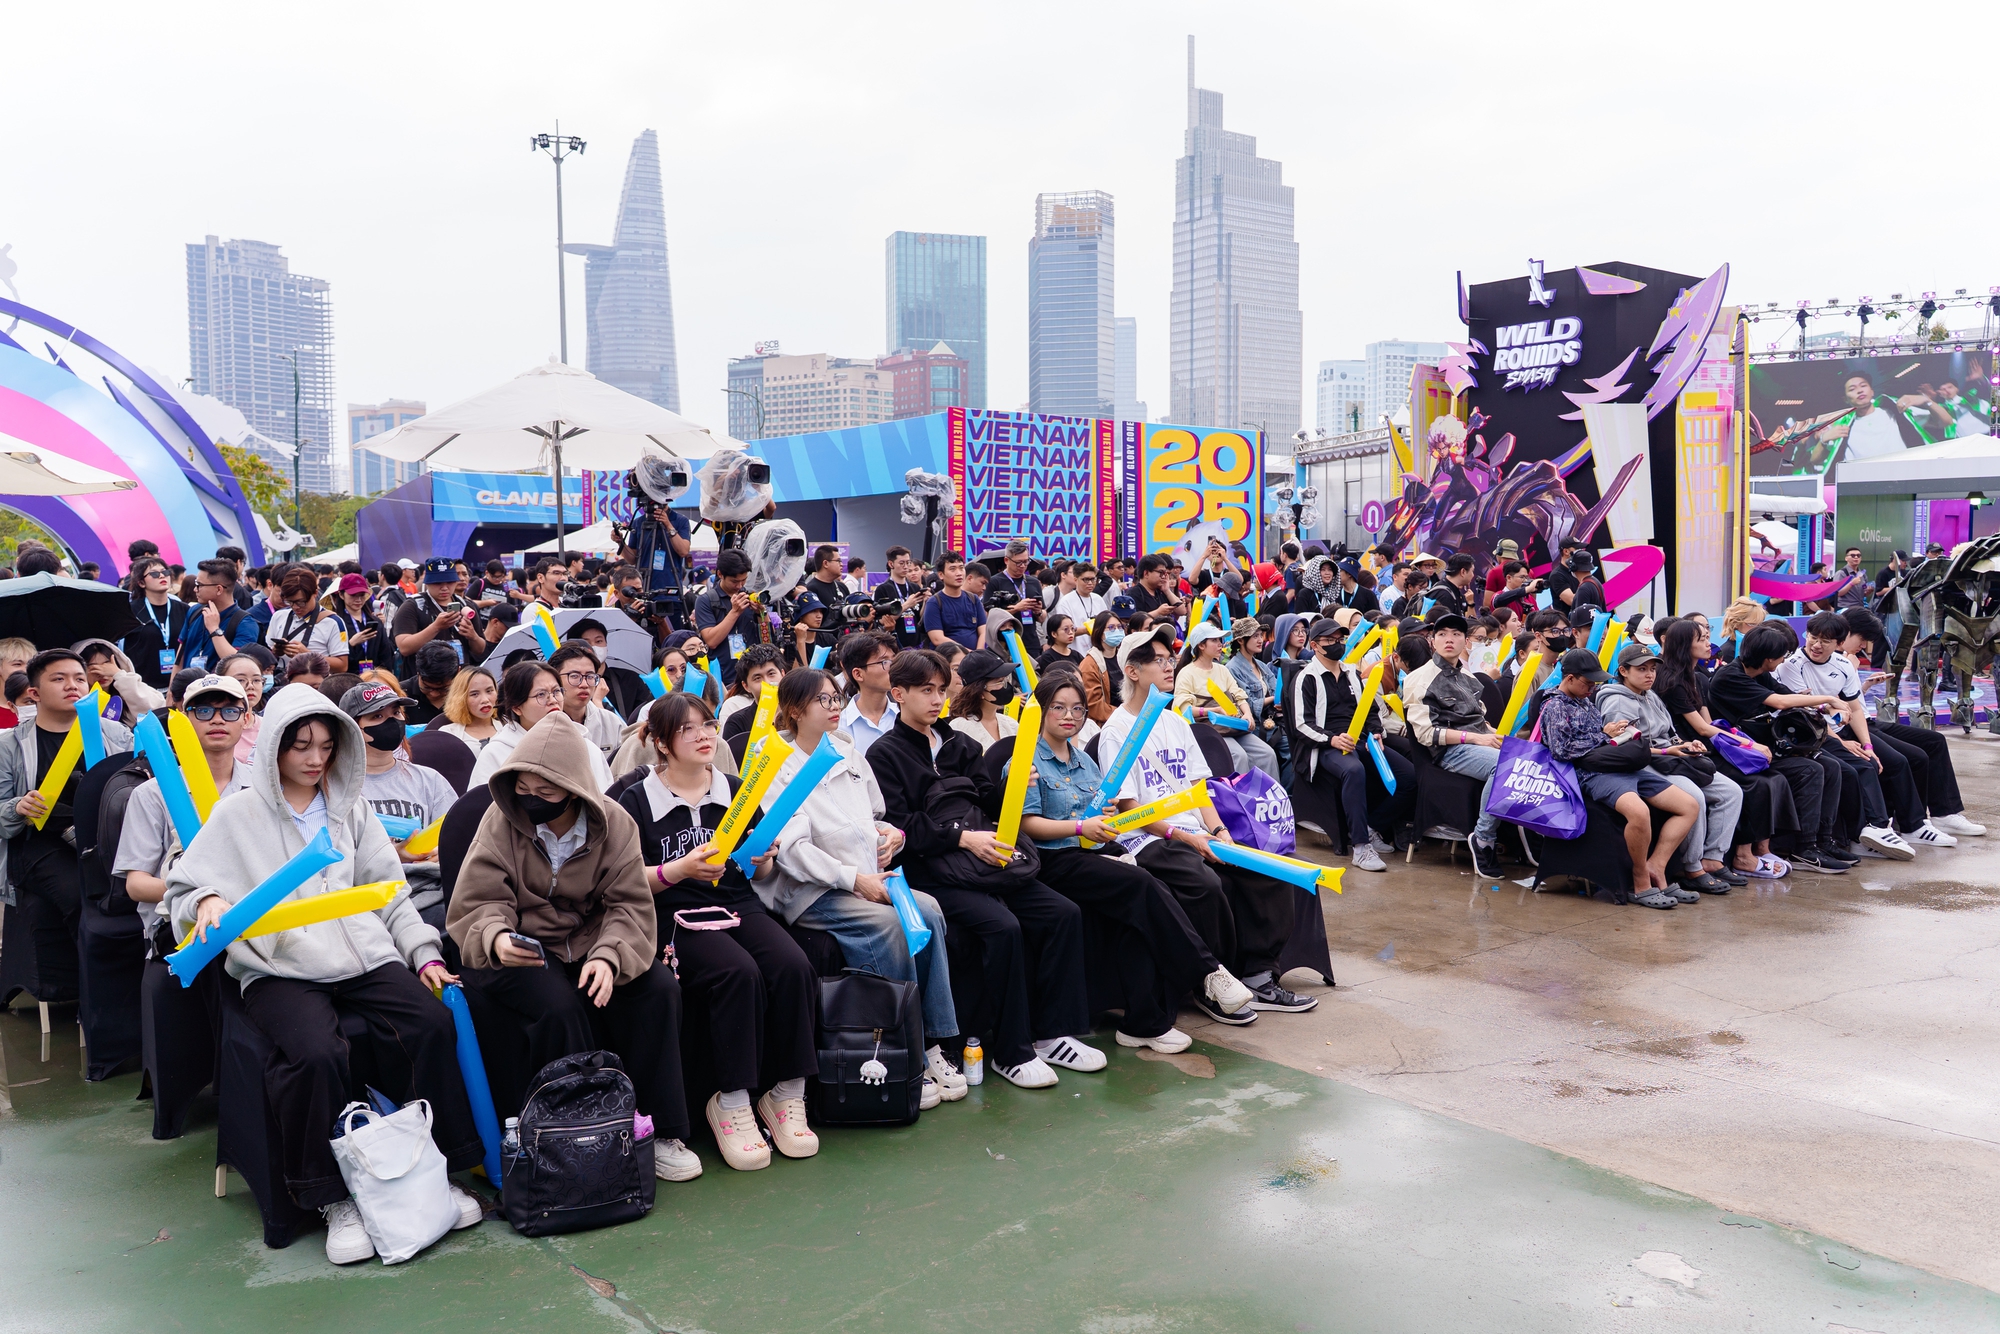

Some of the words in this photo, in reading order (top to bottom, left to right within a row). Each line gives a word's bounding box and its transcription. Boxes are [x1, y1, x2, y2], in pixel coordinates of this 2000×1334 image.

[764, 340, 779, 349] SCB
[1502, 366, 1559, 389] SMASH
[953, 420, 963, 460] VIETNAM
[967, 419, 1091, 448] VIETNAM
[1126, 421, 1135, 442] GONE
[967, 442, 1091, 470] VIETNAM
[1102, 432, 1112, 469] VIETNAM
[1126, 444, 1135, 470] GLORY
[1149, 428, 1255, 486] 20
[967, 465, 1091, 492] VIETNAM
[476, 490, 539, 507] CLAN
[967, 489, 1091, 514] VIETNAM
[1103, 482, 1112, 508] GLORY
[1126, 483, 1136, 519] VIETNAM
[967, 512, 1091, 536] VIETNAM
[1103, 509, 1112, 530] GONE
[953, 529, 963, 552] WILD
[1103, 532, 1113, 553] WILD
[1127, 532, 1136, 552] WILD
[722, 817, 735, 834] WILD
[745, 769, 761, 794] SMASH
[757, 754, 771, 773] 2025
[1506, 791, 1546, 807] SMASH
